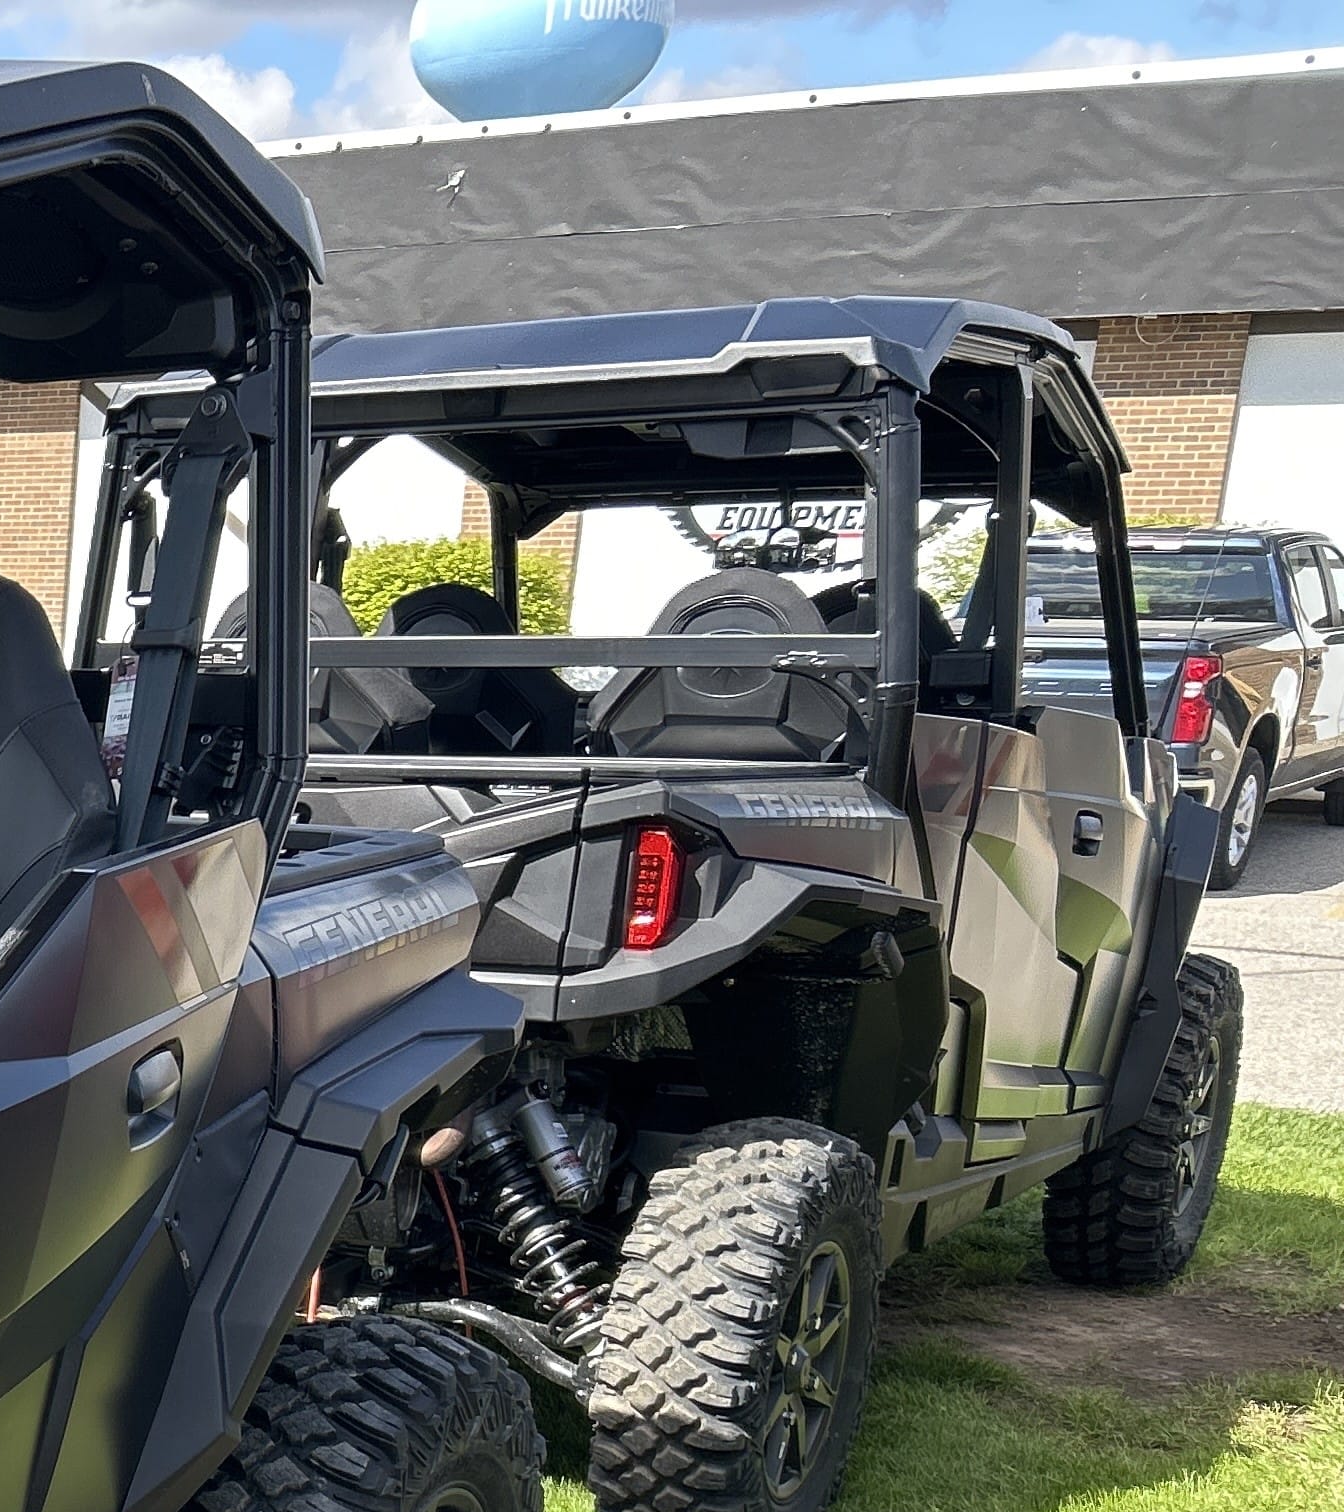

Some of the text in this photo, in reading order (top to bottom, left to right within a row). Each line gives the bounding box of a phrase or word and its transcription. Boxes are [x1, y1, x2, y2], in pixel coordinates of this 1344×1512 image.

[715, 505, 866, 531] EQUPME
[734, 793, 885, 831] GENERAL
[282, 886, 459, 988] GENERAL
